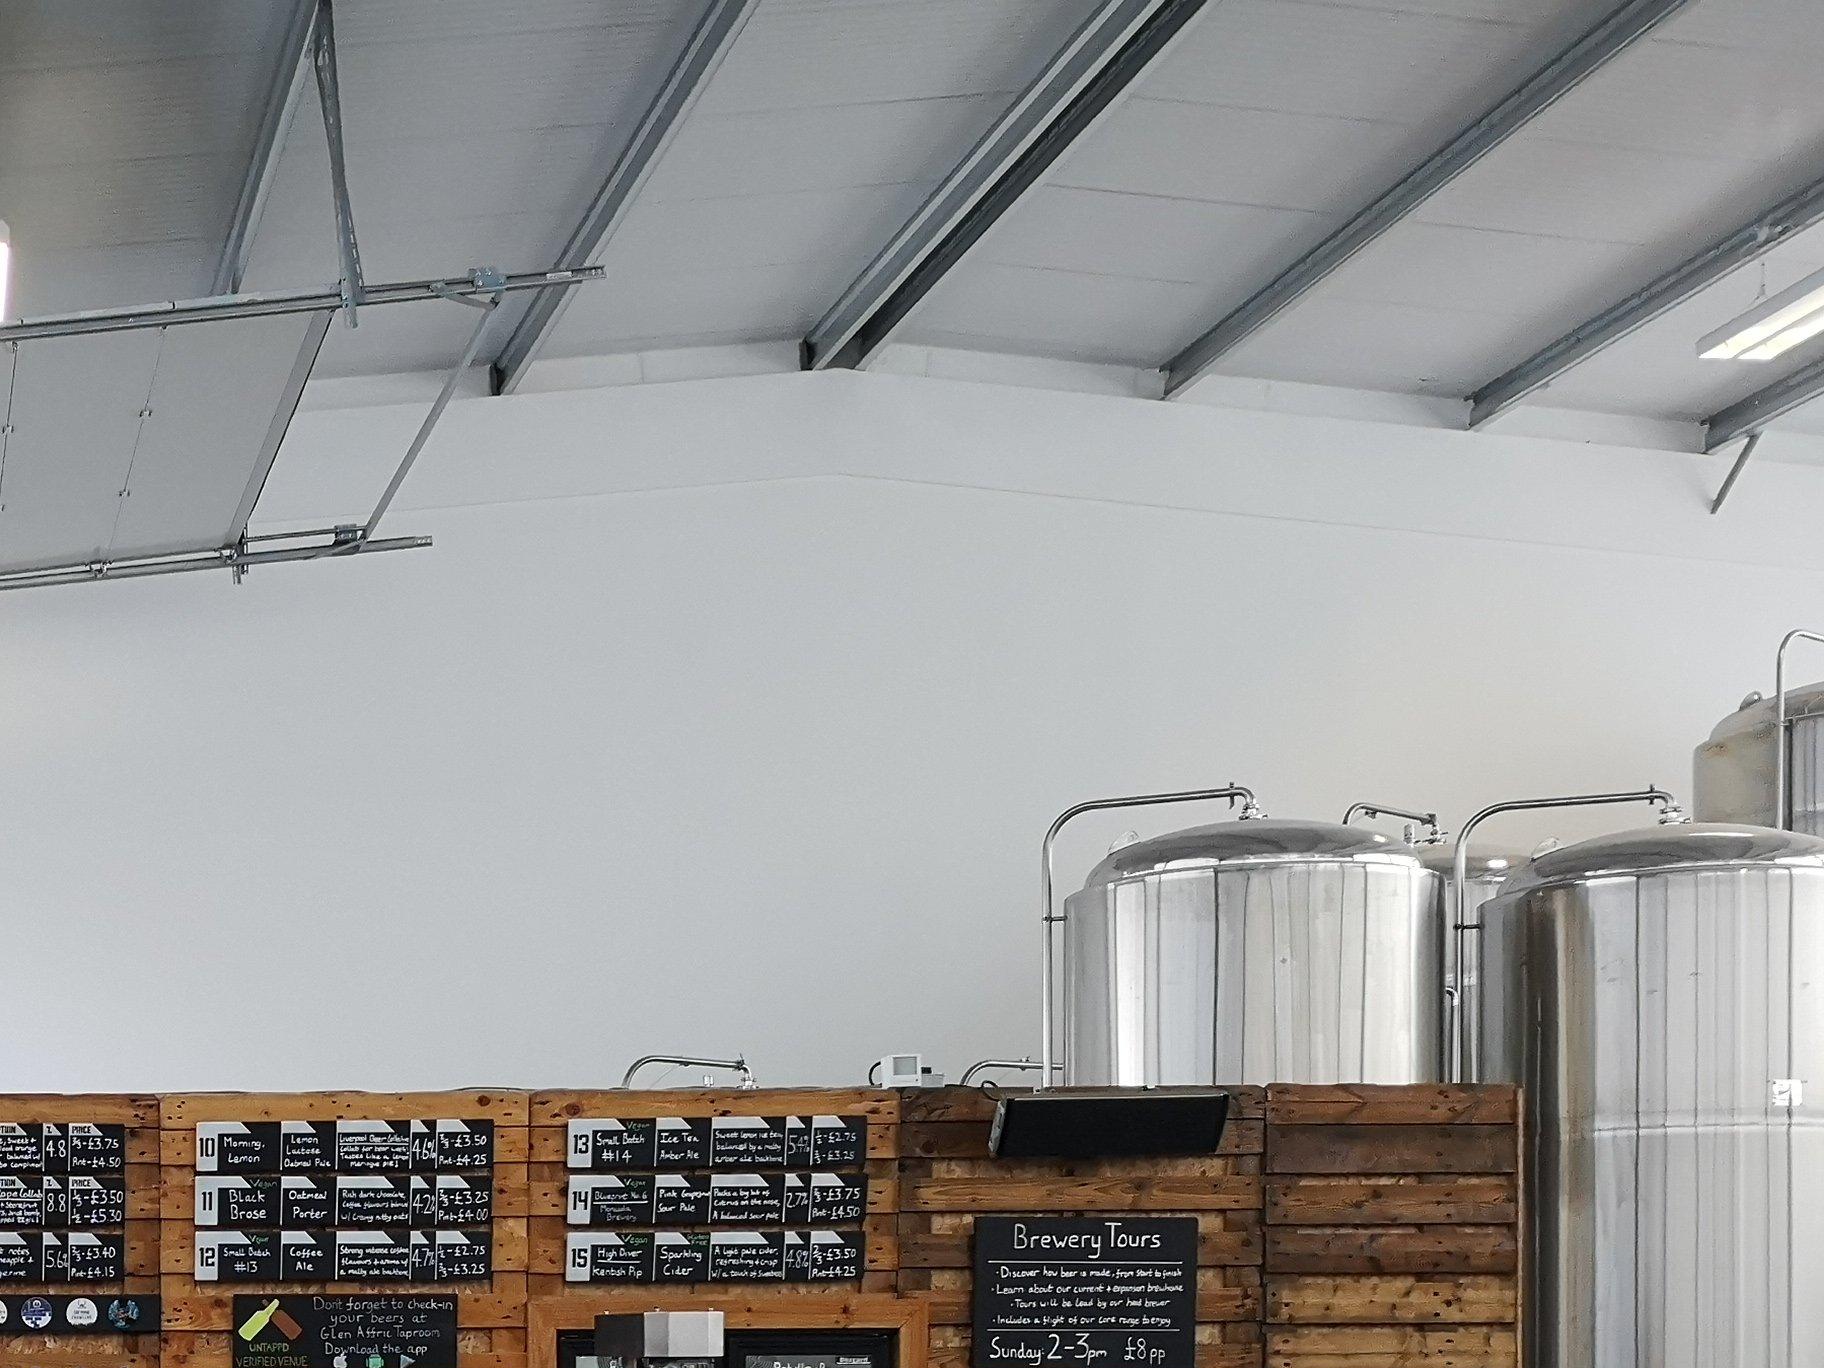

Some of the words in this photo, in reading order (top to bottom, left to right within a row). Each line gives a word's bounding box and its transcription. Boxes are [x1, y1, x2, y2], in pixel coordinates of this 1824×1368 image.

[291, 1135, 318, 1144] Lemon
[573, 1135, 589, 1154] 13
[596, 1132, 620, 1146] Small
[622, 1133, 644, 1144] Batch
[660, 1133, 679, 1143] Ice
[46, 1140, 66, 1157] 4.8
[199, 1137, 215, 1157] 10
[228, 1153, 260, 1163] Lemon
[601, 1150, 632, 1163] #14
[687, 1151, 700, 1159] Ale
[202, 1192, 213, 1211] 11
[229, 1190, 265, 1202] Black
[289, 1190, 327, 1200] Oatmeal
[572, 1192, 588, 1211] 14
[47, 1194, 66, 1212] 8.8
[230, 1205, 267, 1219] Brose
[293, 1207, 327, 1219] Porter
[1013, 1223, 1101, 1259] Brewery
[1105, 1222, 1161, 1248] Tours
[199, 1247, 215, 1267] 12
[224, 1248, 245, 1258] Small
[290, 1247, 324, 1258] Coffee
[572, 1249, 588, 1268] 15
[659, 1247, 702, 1261] Sparkling
[234, 1262, 258, 1273] #13
[296, 1261, 314, 1271] Ale
[663, 1263, 693, 1276] Cider
[1043, 1266, 1058, 1276] how
[1060, 1267, 1077, 1277] beer
[1028, 1284, 1052, 1293] about
[346, 1298, 388, 1313] forget
[391, 1298, 403, 1309] to
[407, 1299, 453, 1310] check-in
[1097, 1299, 1106, 1309] by
[330, 1313, 364, 1327] your
[371, 1313, 404, 1323] beers
[412, 1315, 427, 1323] at
[321, 1327, 351, 1339] Glen
[357, 1327, 392, 1338] Affric
[394, 1326, 440, 1340] Taproom
[326, 1343, 379, 1354] Download
[383, 1343, 401, 1353] the
[407, 1345, 427, 1355] app
[1047, 1333, 1107, 1365] 2-3pm
[1124, 1337, 1146, 1360] £8
[1150, 1349, 1165, 1364] pp
[236, 1356, 276, 1367] VERIFIED
[278, 1356, 308, 1366] VENUE
